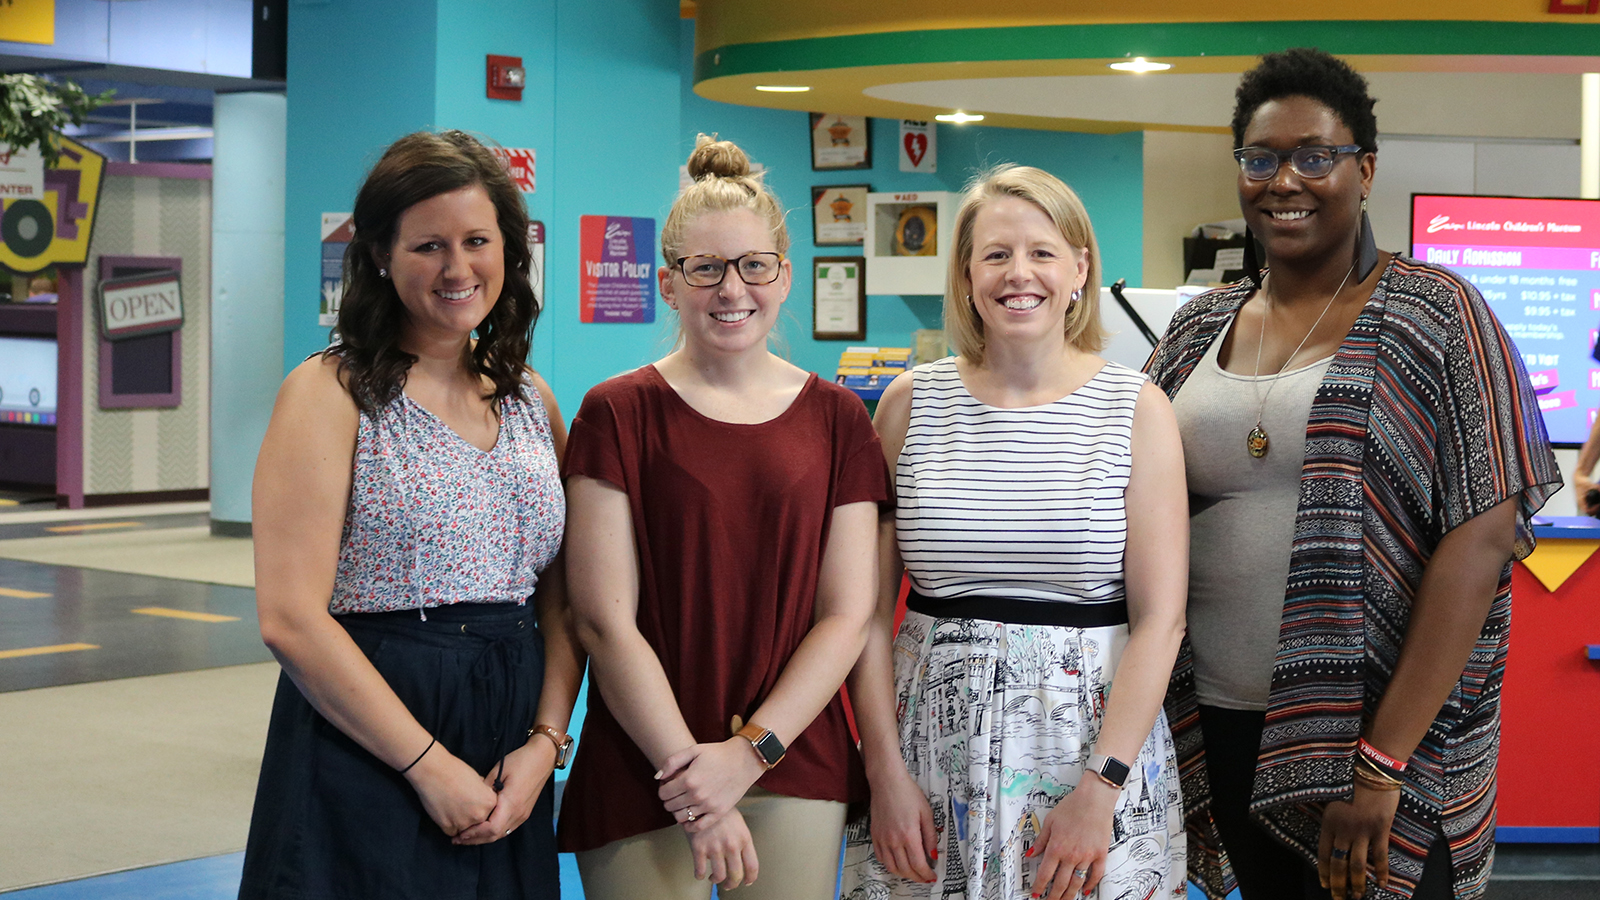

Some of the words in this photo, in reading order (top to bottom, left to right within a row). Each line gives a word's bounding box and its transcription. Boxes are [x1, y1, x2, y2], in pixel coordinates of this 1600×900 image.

[1467, 221, 1500, 231] Lincoln
[1503, 221, 1545, 232] Children's
[1547, 222, 1582, 233] Museum
[1463, 248, 1522, 267] ADMISSION
[586, 260, 620, 278] VISITOR
[622, 260, 651, 279] POLICY
[1479, 275, 1507, 284] under
[1520, 276, 1555, 286] months
[1558, 276, 1578, 286] free
[1560, 292, 1576, 302] tax
[110, 290, 176, 321] OPEN
[1560, 308, 1576, 317] tax
[1360, 743, 1395, 767] NEBRASKA
